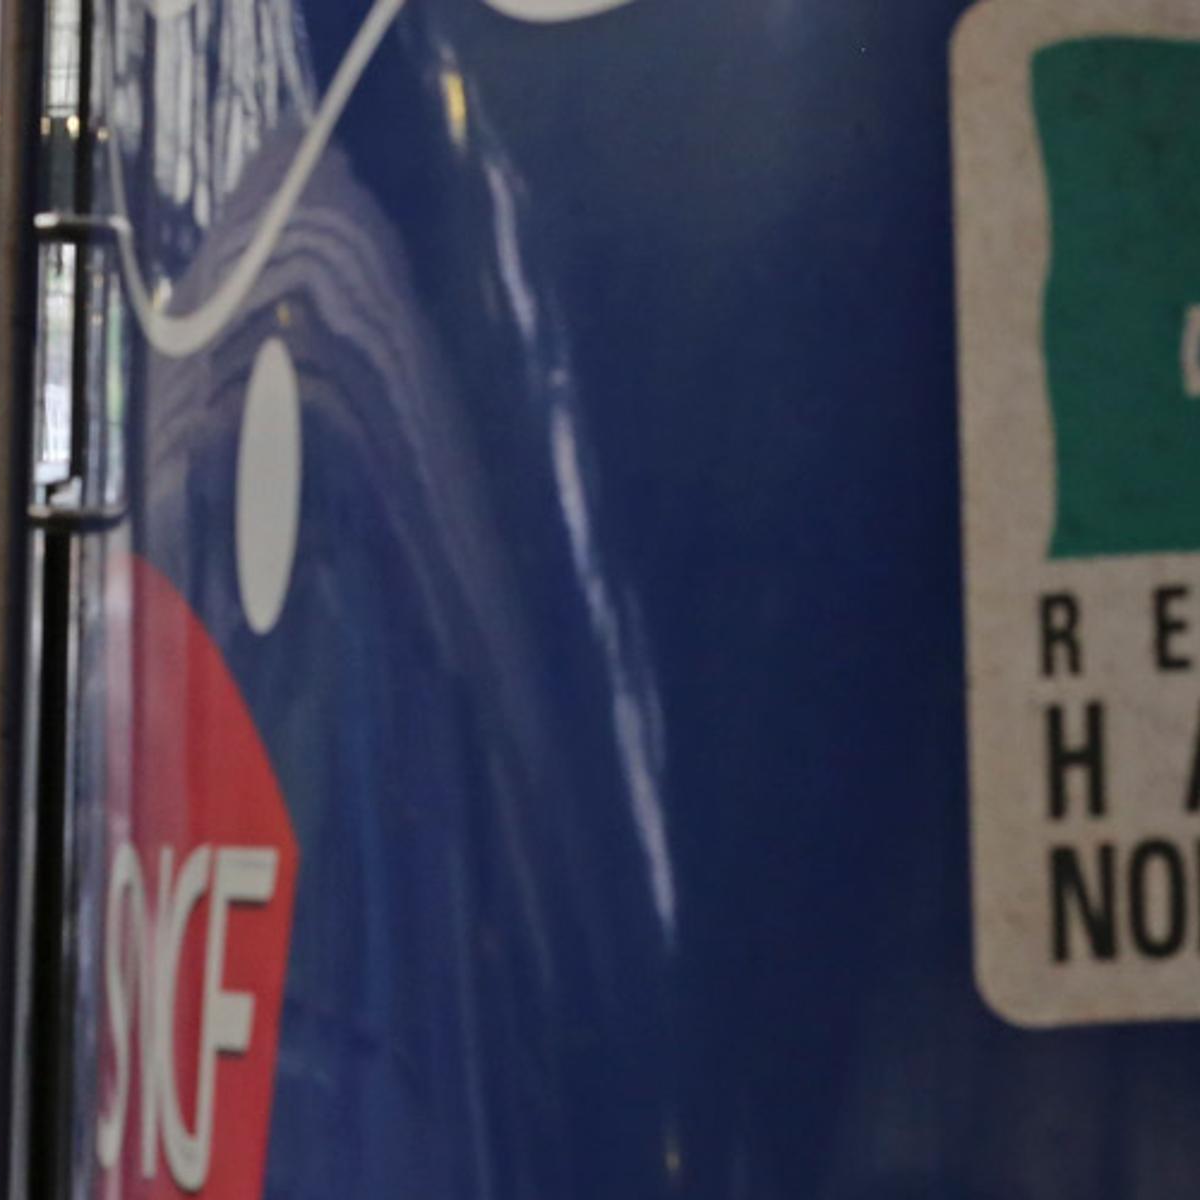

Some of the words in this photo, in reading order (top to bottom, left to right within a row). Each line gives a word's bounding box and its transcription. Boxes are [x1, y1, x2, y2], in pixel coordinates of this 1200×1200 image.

[1047, 700, 1200, 821] H
[1050, 837, 1200, 963] NO
[96, 842, 280, 1192] SNCF
